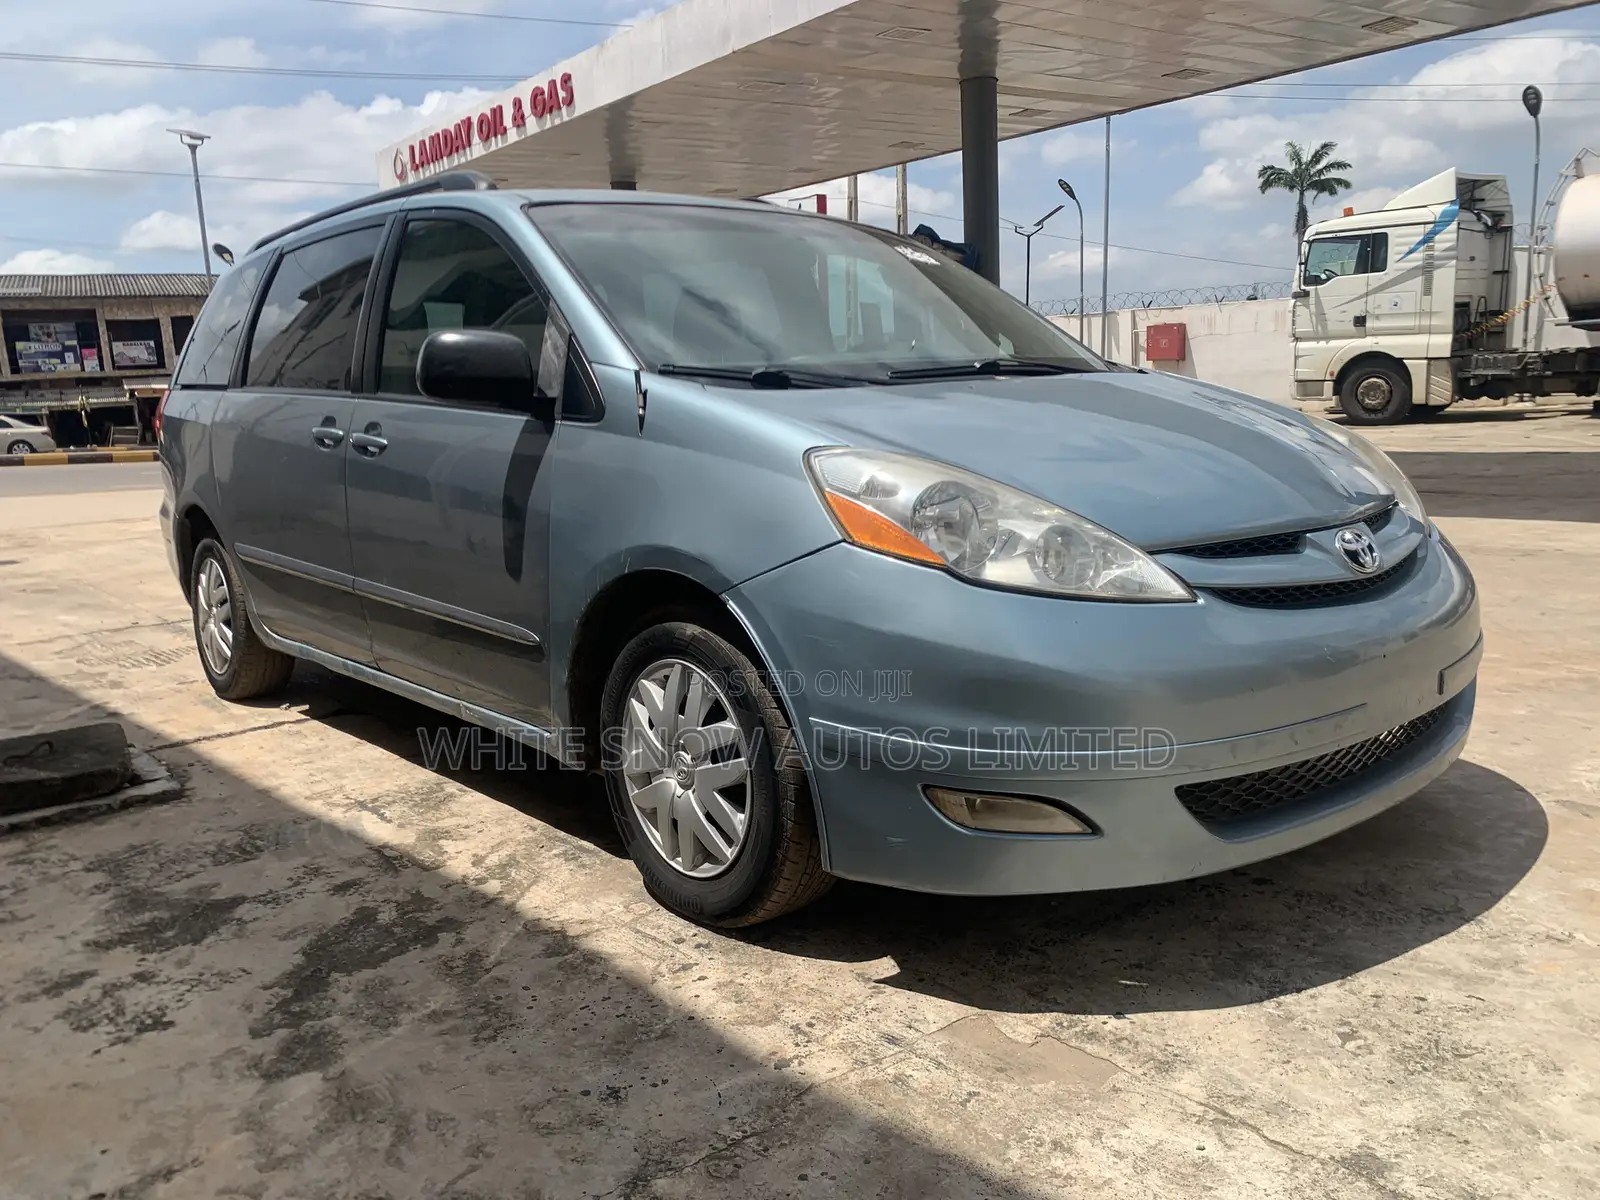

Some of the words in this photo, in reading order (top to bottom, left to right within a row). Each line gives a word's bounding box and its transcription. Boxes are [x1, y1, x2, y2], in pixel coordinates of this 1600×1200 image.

[409, 116, 472, 172] LAMDAY
[477, 105, 507, 142] OIL
[512, 97, 525, 128] &
[530, 72, 575, 118] GAS
